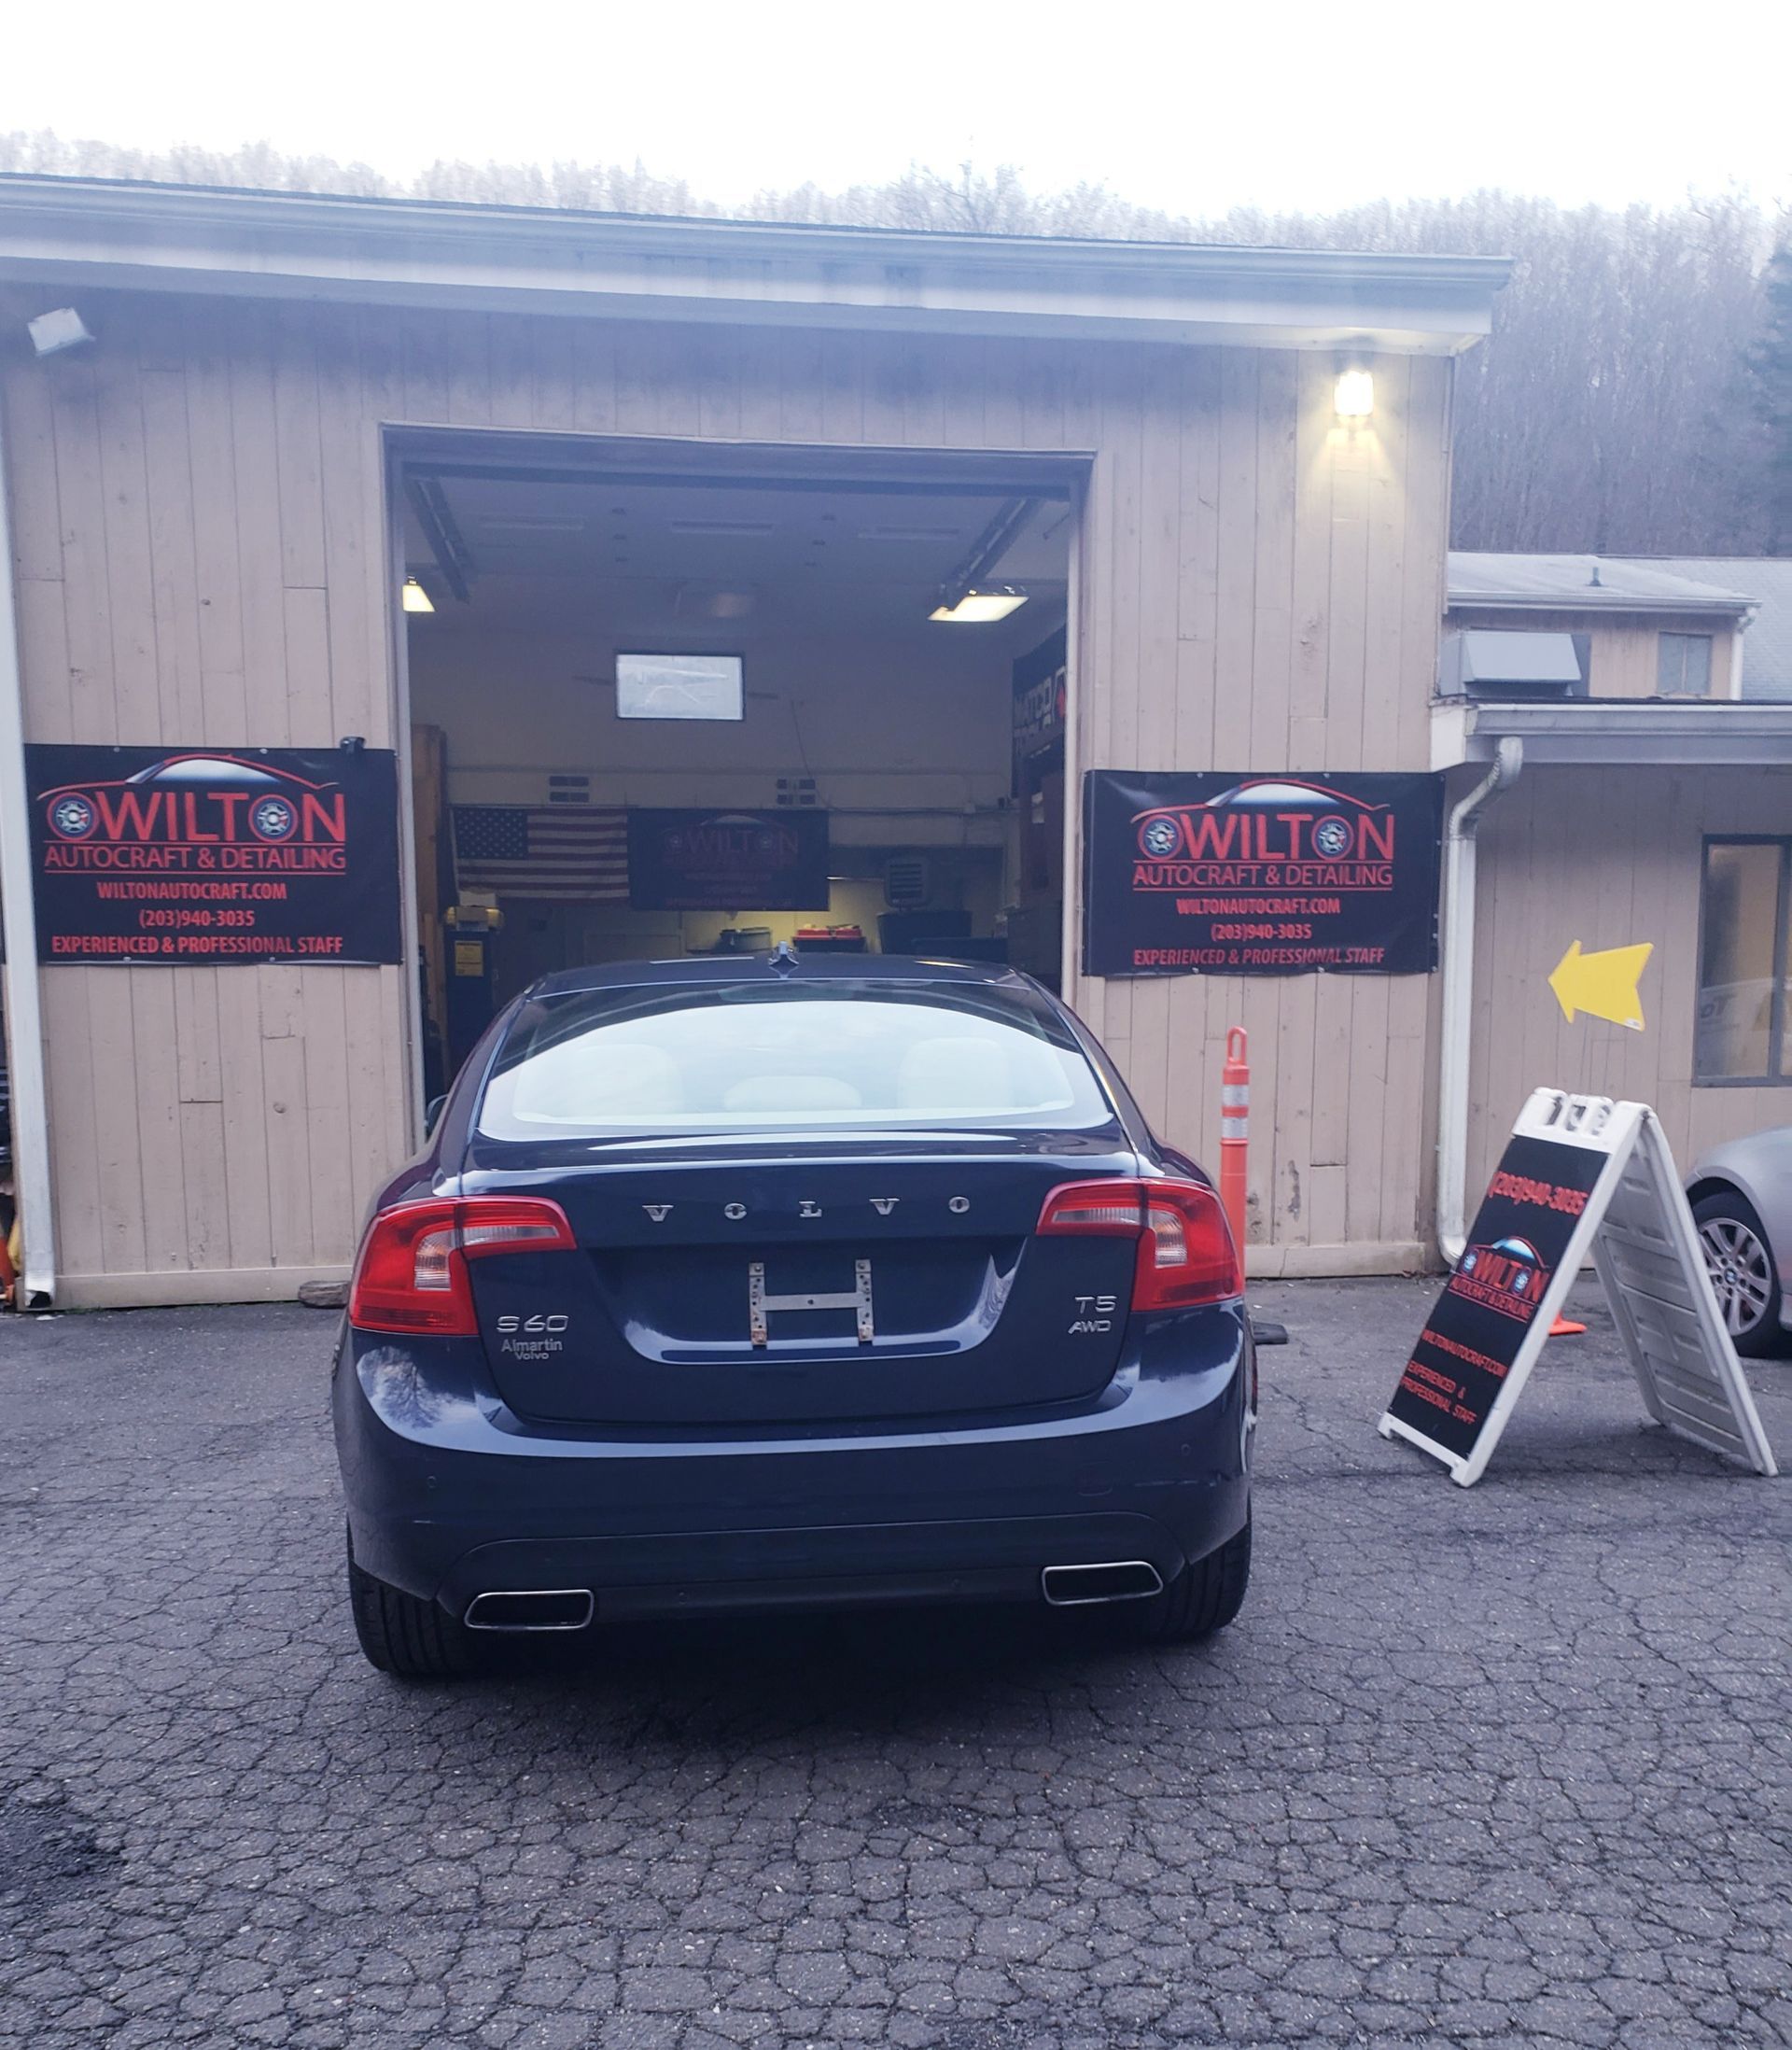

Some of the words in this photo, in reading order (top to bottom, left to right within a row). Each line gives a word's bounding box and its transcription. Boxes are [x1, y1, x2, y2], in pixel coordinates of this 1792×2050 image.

[45, 846, 191, 869] AUTOCRAFT
[197, 848, 216, 869] &
[222, 847, 346, 869] DETAILING
[1133, 864, 1261, 886] AUTOCRAFT
[1266, 864, 1281, 885] &
[1285, 864, 1393, 886] DETAILING
[97, 881, 287, 901] WILTONAUTOCRAFT.COM
[1176, 898, 1341, 915] WILTONAUTOCRAFT.COM
[139, 909, 255, 928] (203)940-3035
[1211, 923, 1312, 942] (203)940-3035
[52, 936, 159, 954] EXPERIENCED
[161, 937, 175, 954] &
[177, 936, 295, 954] PROFESSIONAL
[298, 936, 343, 954] STAFF
[1134, 948, 1225, 965] EXPERIENCED
[1228, 950, 1240, 964] &
[1242, 948, 1342, 964] PROFESSIONAL
[1345, 947, 1385, 963] STAFF
[642, 1196, 971, 1222] VOLVO
[1074, 1295, 1117, 1313] T5
[497, 1314, 569, 1333] S60
[1068, 1319, 1112, 1335] AWD
[501, 1338, 563, 1352] Almartin
[514, 1351, 549, 1360] Volvo
